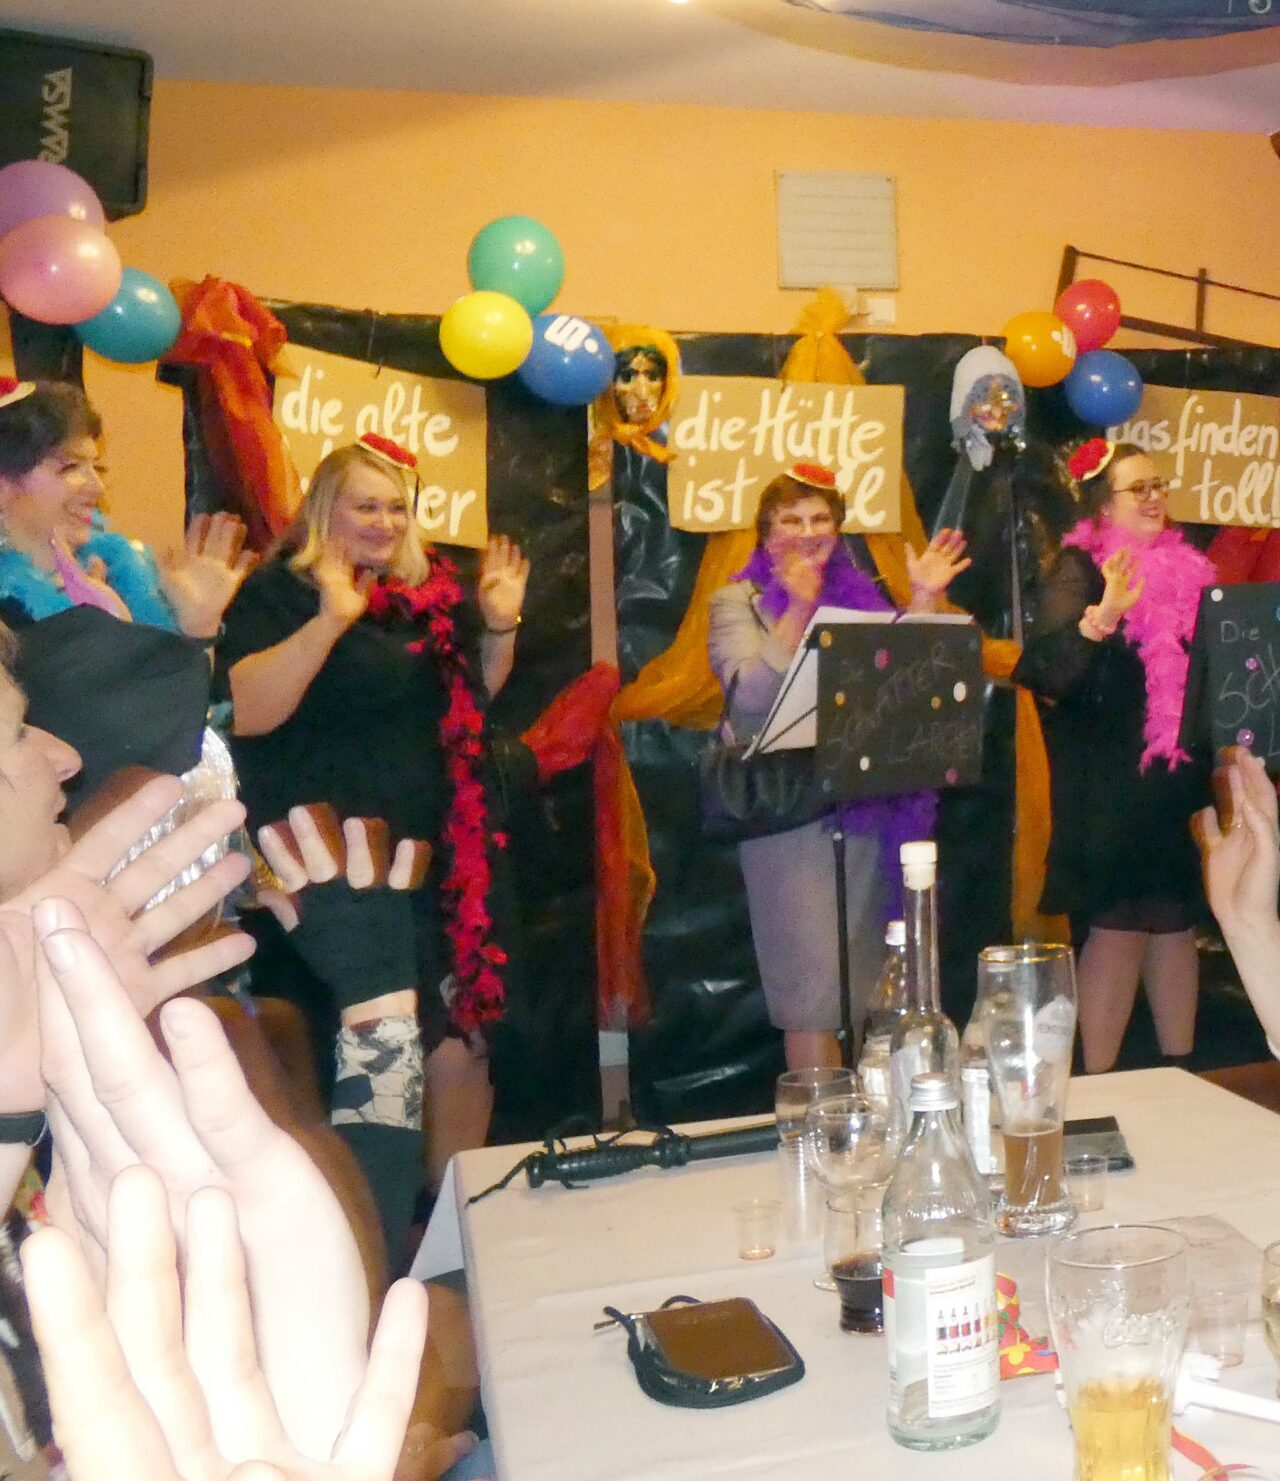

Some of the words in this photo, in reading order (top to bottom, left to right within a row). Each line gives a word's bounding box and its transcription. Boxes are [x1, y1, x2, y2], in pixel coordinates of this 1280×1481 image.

[281, 364, 345, 436] die
[355, 381, 460, 458] alte
[675, 389, 747, 452] die
[749, 386, 886, 468] Hütte
[1169, 395, 1279, 477] finden
[682, 454, 758, 525] ist
[1220, 618, 1261, 643] Die
